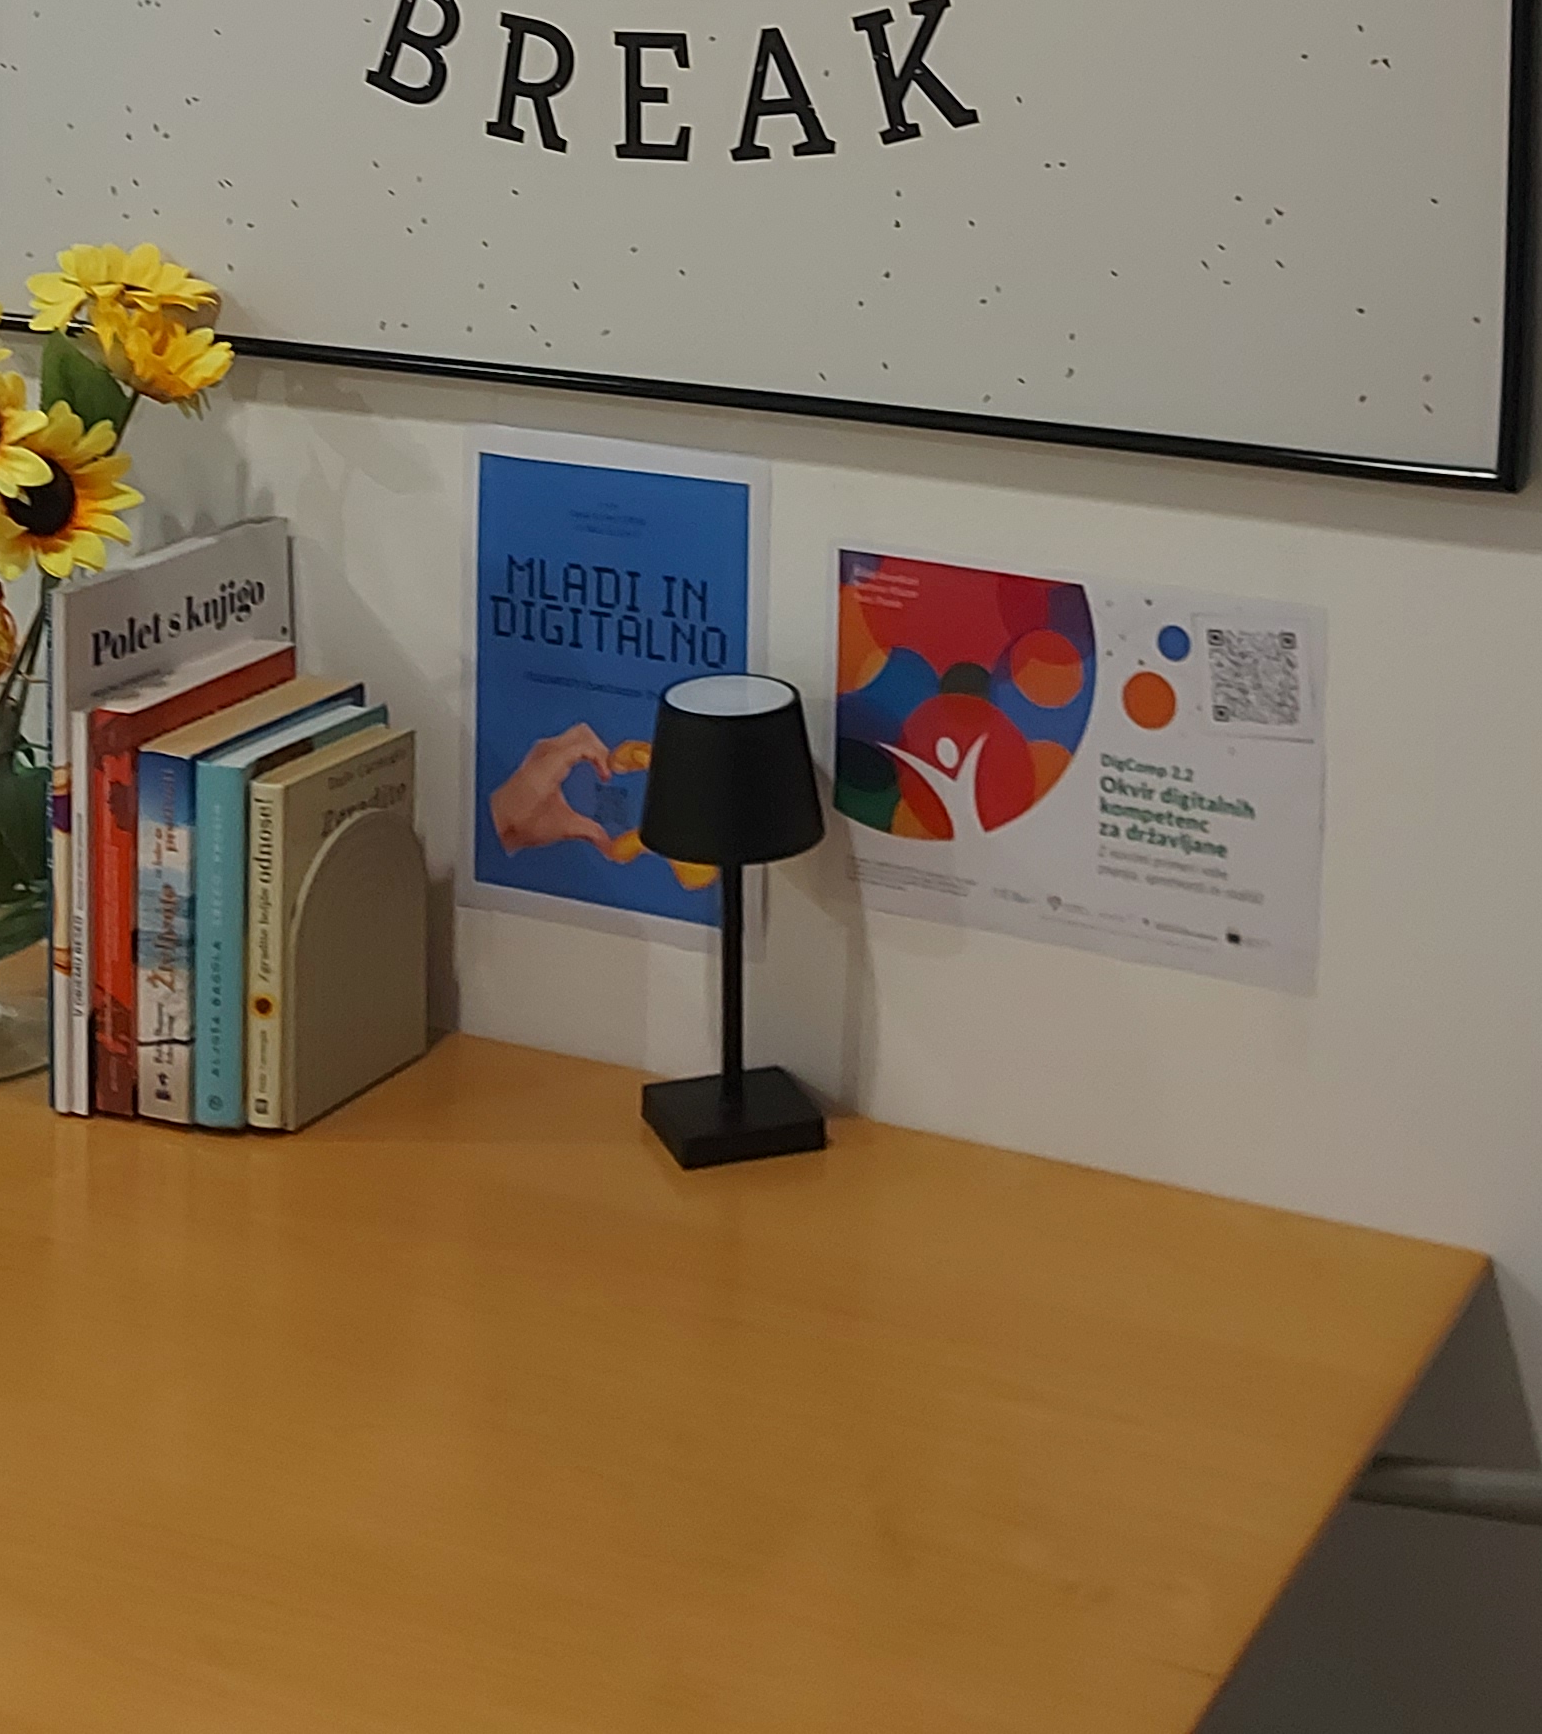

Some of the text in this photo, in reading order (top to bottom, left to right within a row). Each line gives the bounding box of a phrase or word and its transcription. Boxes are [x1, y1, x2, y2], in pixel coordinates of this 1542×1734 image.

[506, 554, 709, 622] MLADI IN
[92, 579, 265, 666] Polet s knjigo
[490, 595, 727, 670] DIGITALNO
[1099, 796, 1209, 833] kompetenc
[1100, 776, 1256, 820] Okvir digitalnih
[1099, 822, 1227, 858] za državljane
